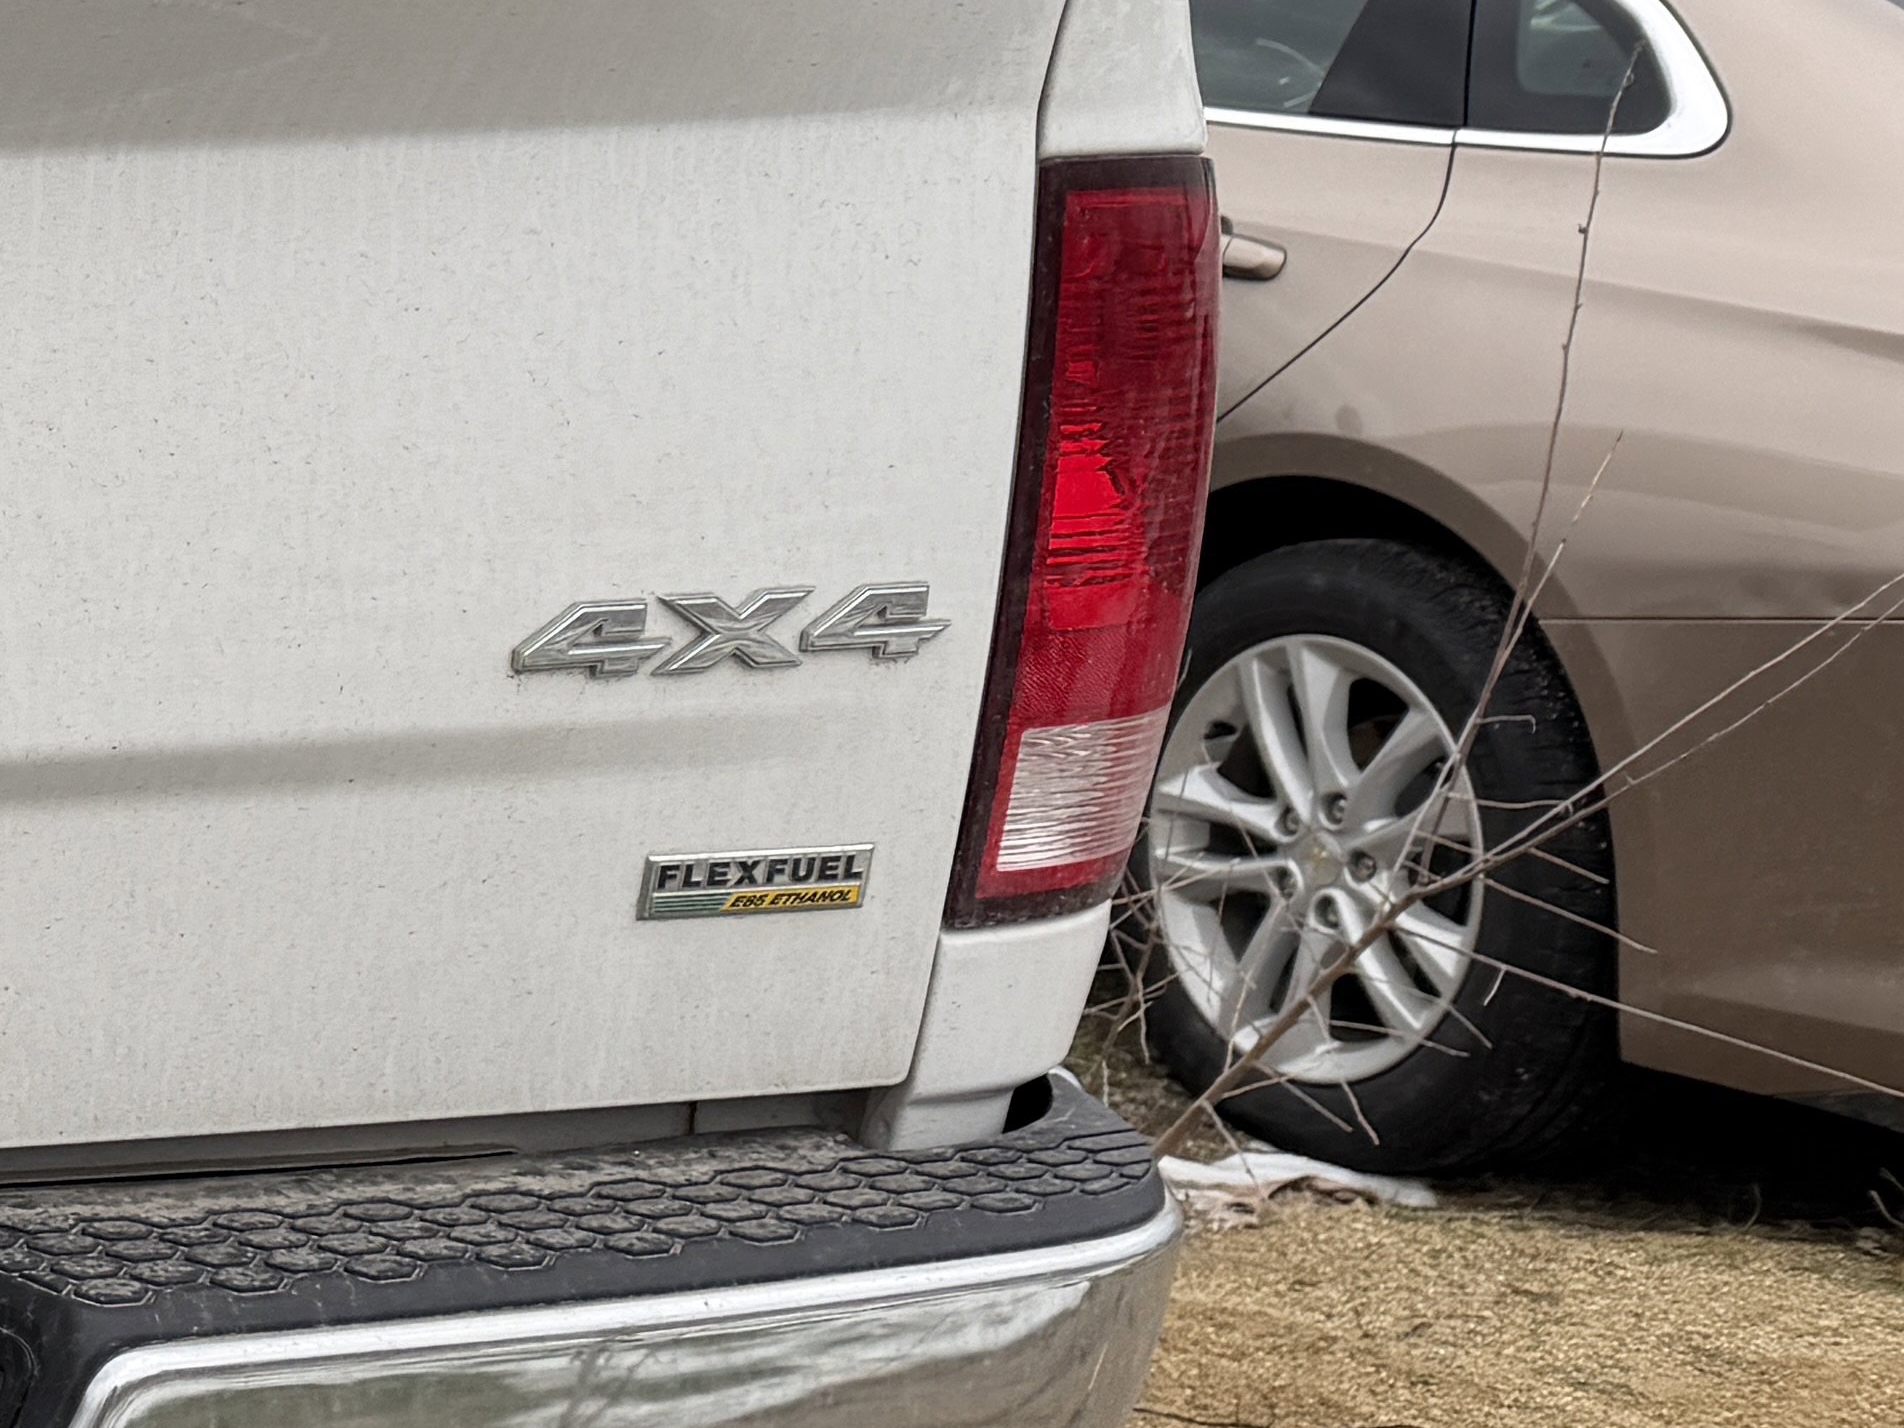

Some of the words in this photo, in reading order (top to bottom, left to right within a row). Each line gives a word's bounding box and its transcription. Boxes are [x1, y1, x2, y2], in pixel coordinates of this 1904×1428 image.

[511, 581, 952, 677] 4X4
[729, 894, 766, 909] E85
[769, 888, 854, 906] ETHANOL
